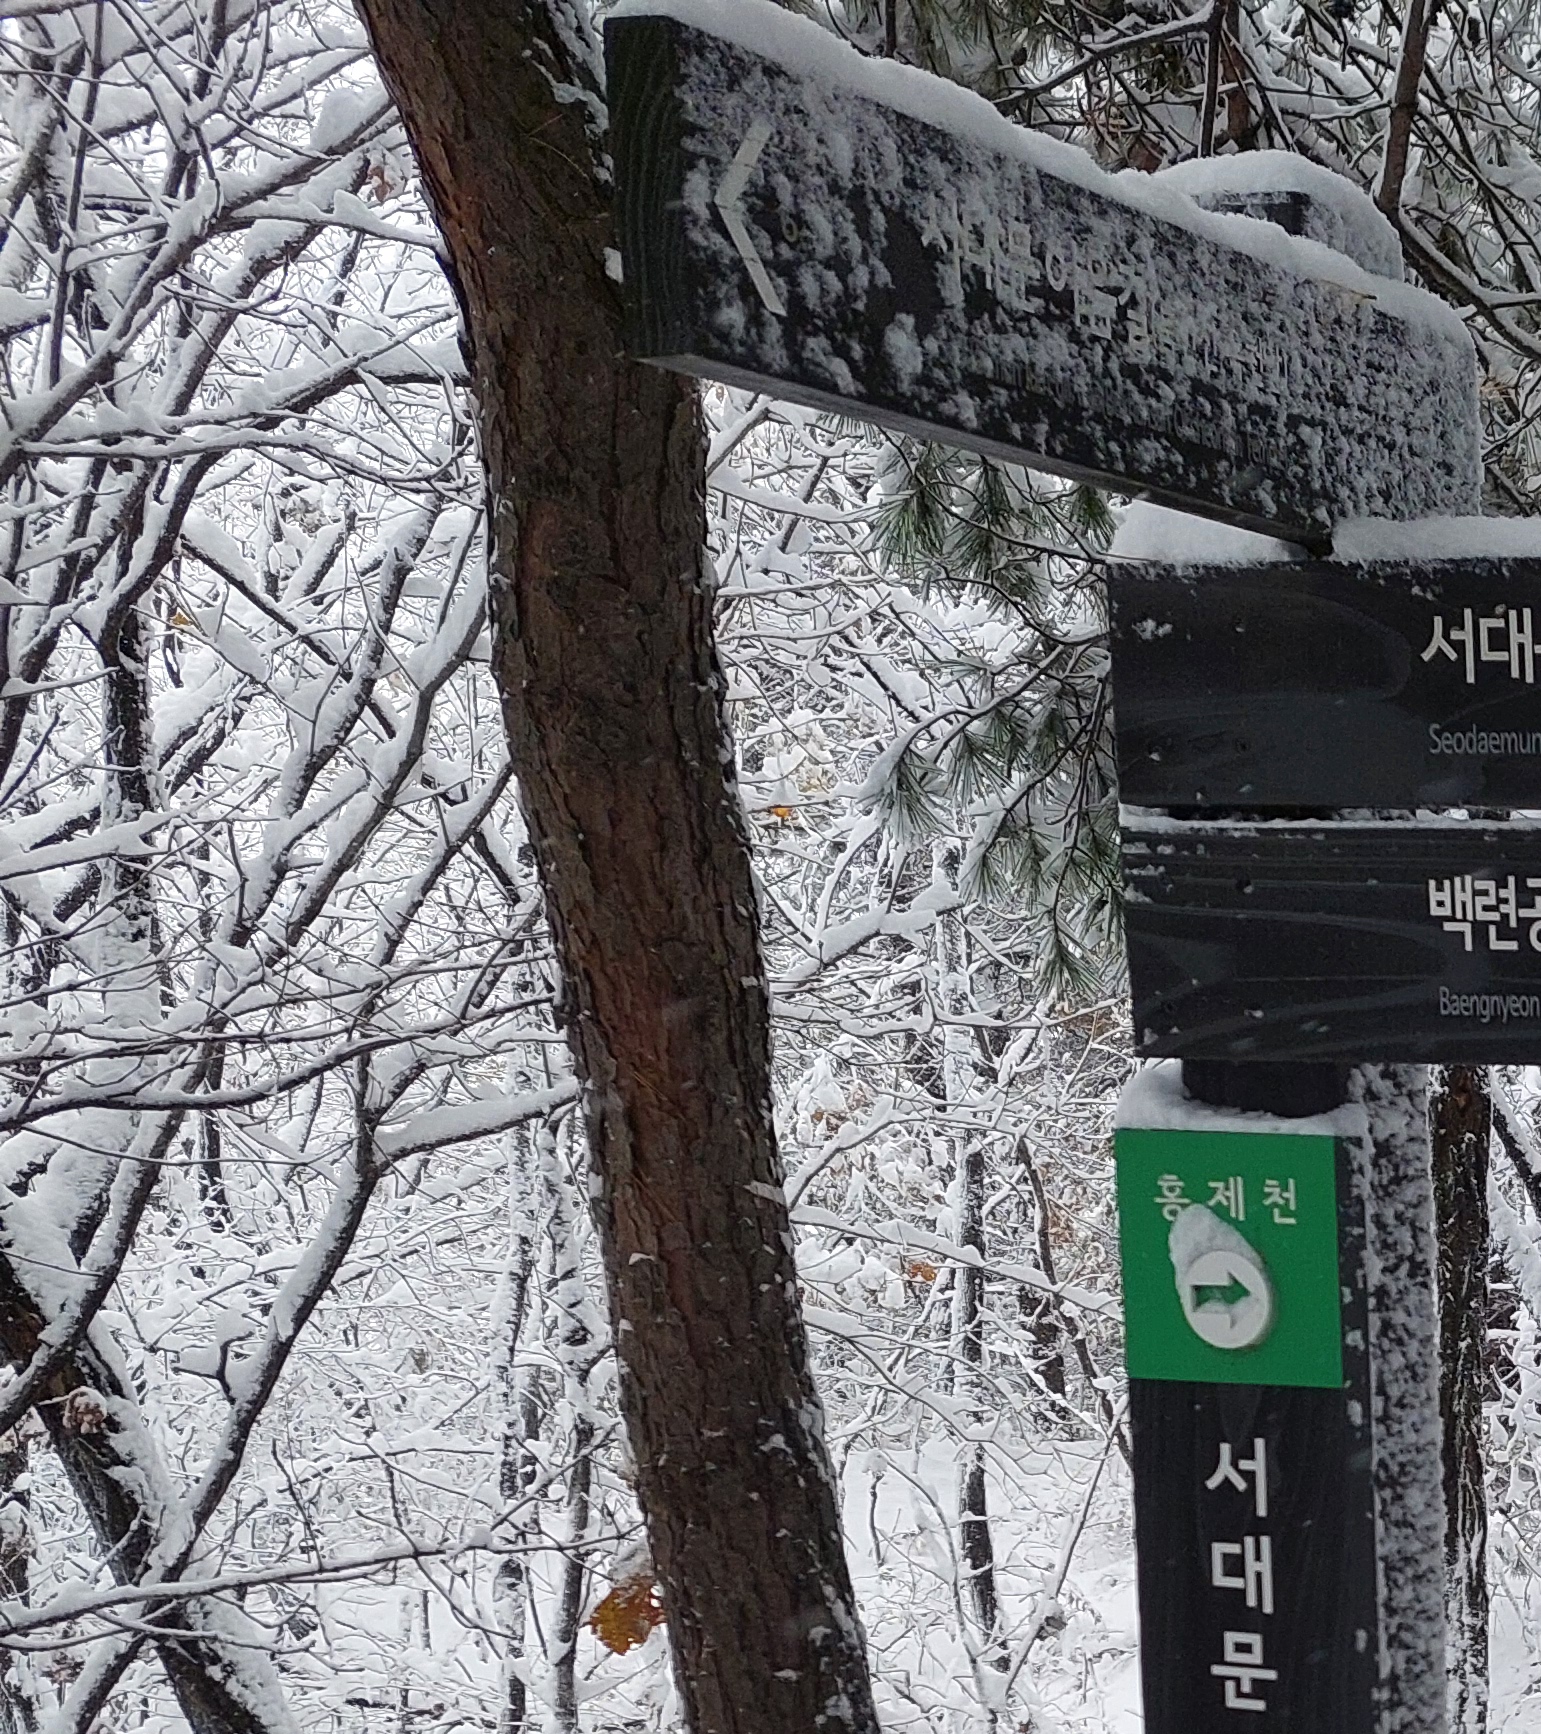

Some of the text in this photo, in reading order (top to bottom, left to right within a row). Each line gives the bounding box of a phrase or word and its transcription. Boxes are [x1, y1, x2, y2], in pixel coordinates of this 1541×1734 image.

[1439, 986, 1540, 1023] Baengnyeon
[1154, 1174, 1297, 1225] 홍제천
[1206, 1438, 1278, 1712] 서대문
